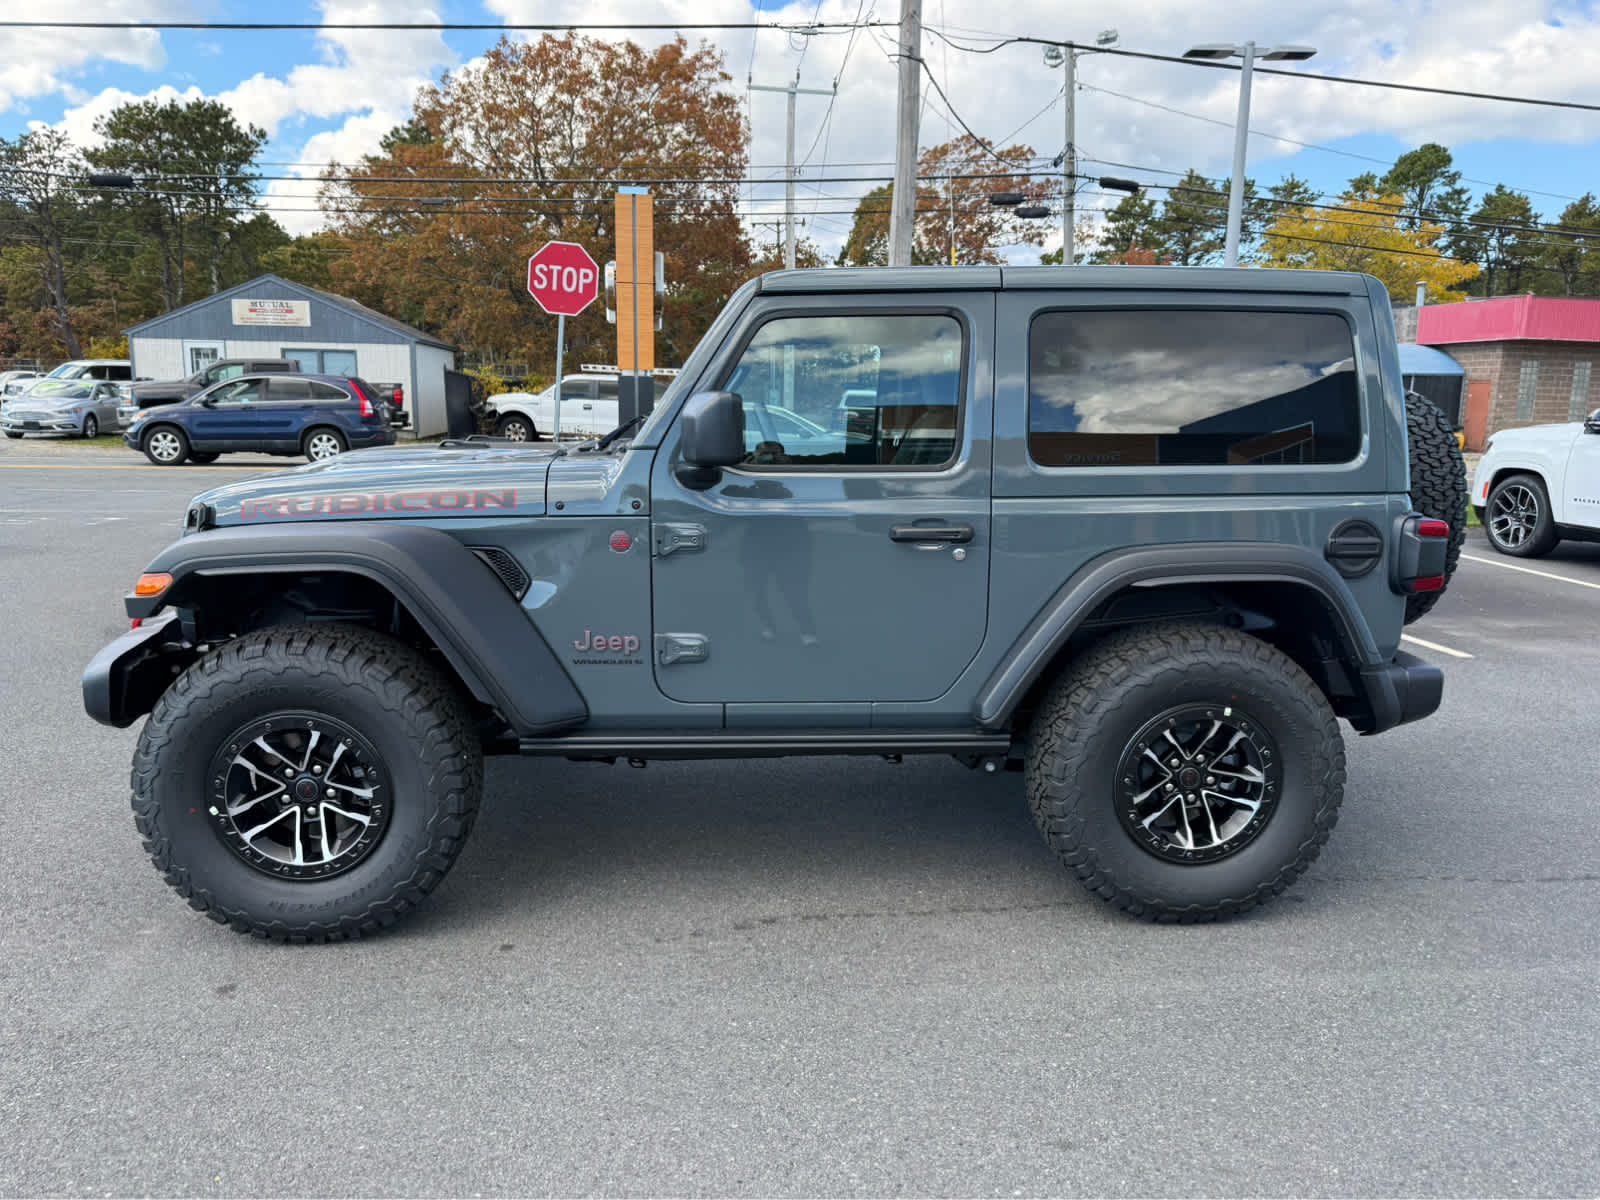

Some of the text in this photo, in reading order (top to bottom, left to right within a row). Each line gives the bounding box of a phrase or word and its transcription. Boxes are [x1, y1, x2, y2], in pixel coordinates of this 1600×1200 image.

[533, 264, 594, 294] STOP
[240, 489, 518, 519] RUBICON
[574, 630, 640, 656] Jeep
